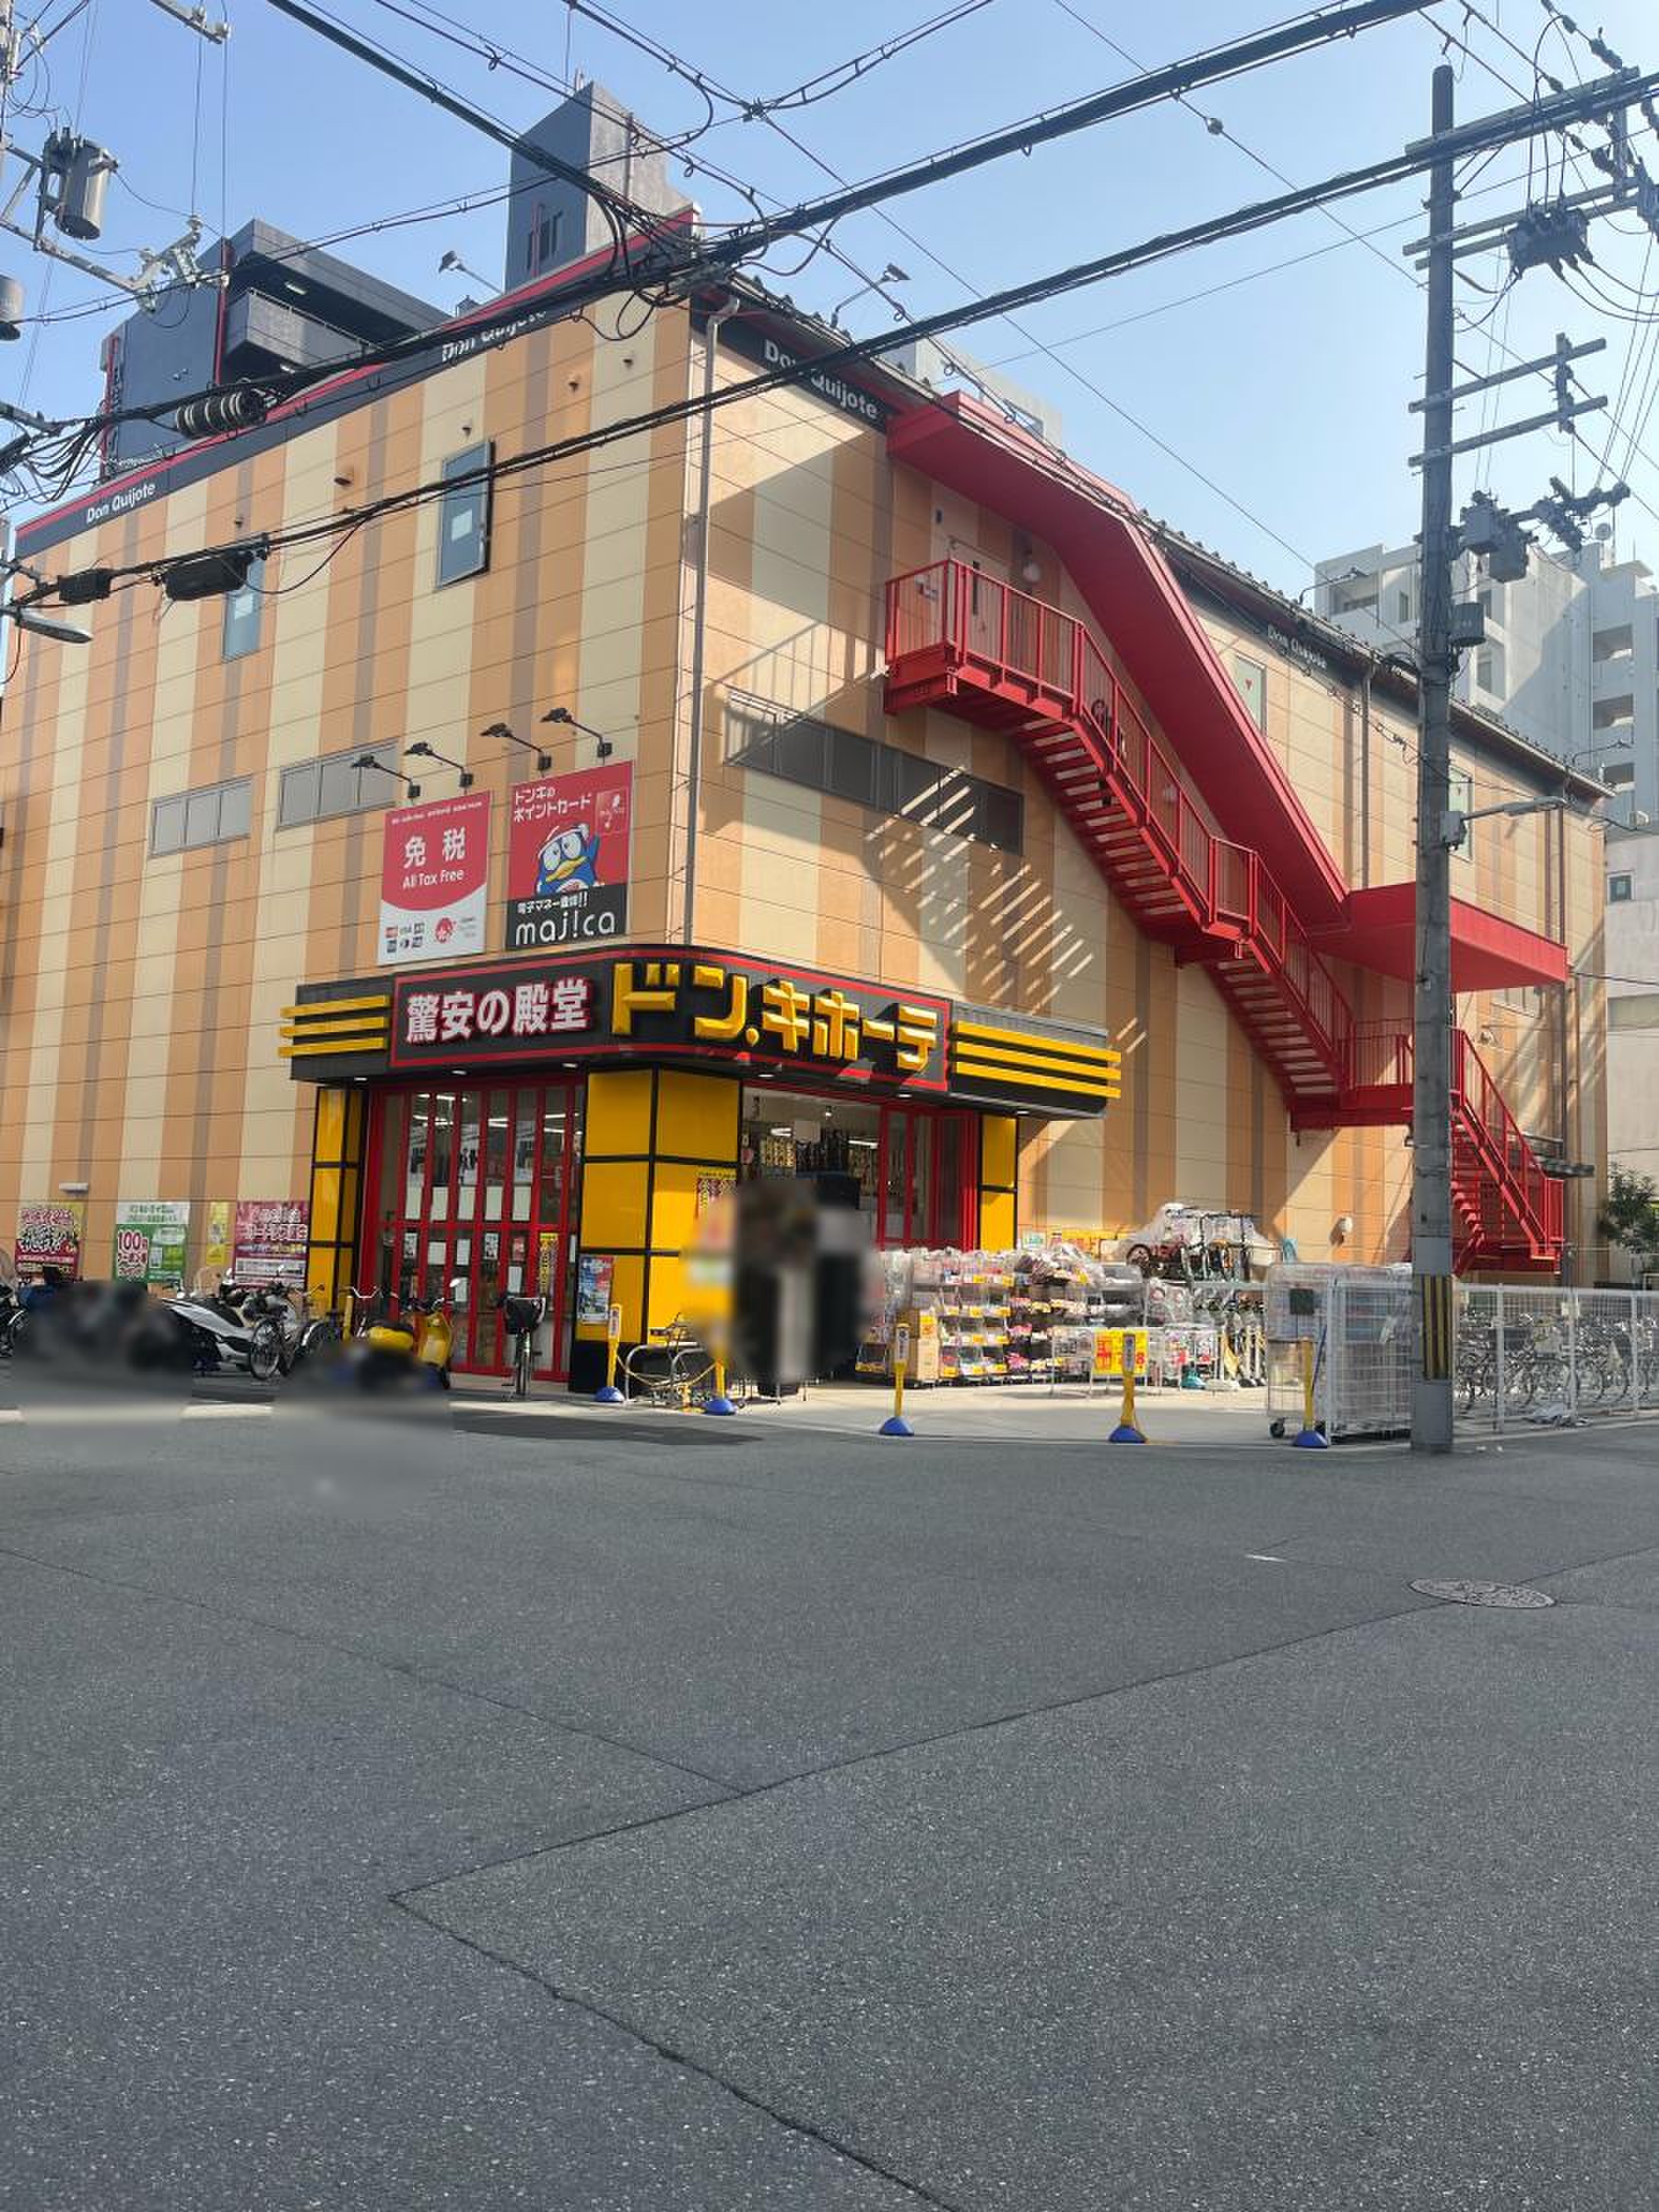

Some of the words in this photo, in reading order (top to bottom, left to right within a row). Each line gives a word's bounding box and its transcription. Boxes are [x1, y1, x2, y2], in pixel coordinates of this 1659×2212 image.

[810, 370, 877, 419] Quijote
[87, 503, 110, 524] Don
[112, 483, 156, 509] Quijote
[513, 792, 593, 823] ポイントカード
[419, 873, 438, 887] Tax
[440, 869, 465, 883] Free
[406, 978, 588, 1044] 驚安の殿堂
